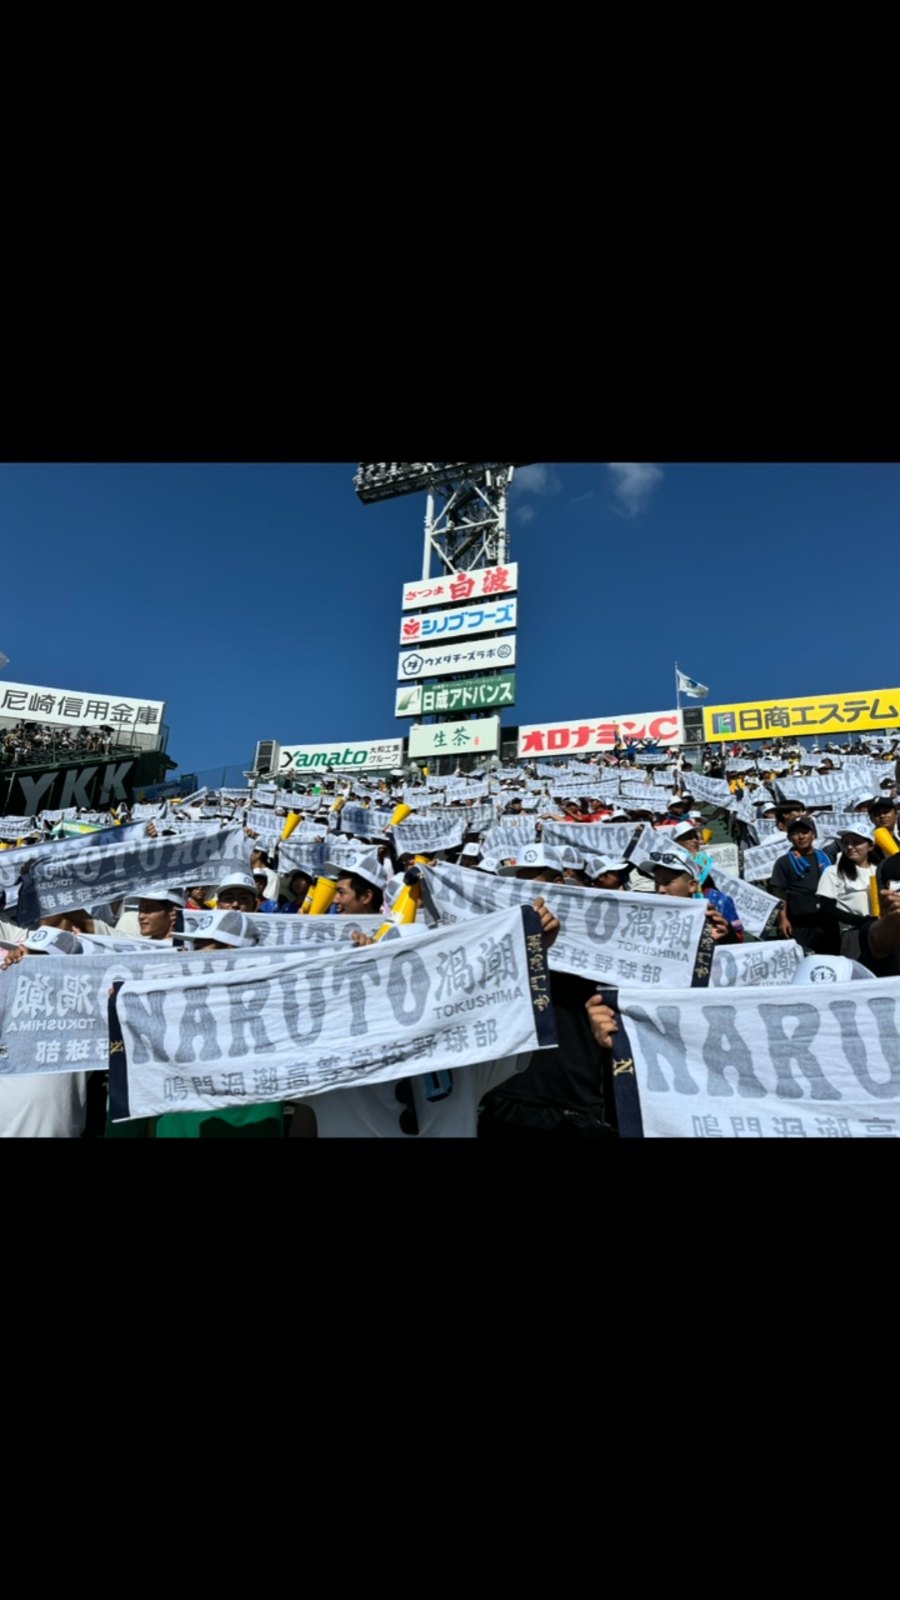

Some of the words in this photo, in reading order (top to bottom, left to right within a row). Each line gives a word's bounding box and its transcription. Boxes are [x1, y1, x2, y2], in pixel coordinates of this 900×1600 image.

[405, 587, 444, 601] さつま
[449, 567, 513, 600] 白波
[422, 604, 514, 635] シノブフーズ
[425, 648, 498, 667] ウメダチーズラボ
[1, 689, 160, 725] 尼崎信用金庫
[423, 682, 513, 711] 日成アドバンス
[739, 698, 899, 731] 日商エステム
[433, 727, 471, 748] 生茶
[522, 716, 679, 752] オロナミンC
[281, 748, 368, 768] Yamato
[369, 751, 398, 763] グループ
[18, 761, 134, 816] YKK
[617, 940, 690, 963] TOKUSHIMA
[122, 949, 431, 1066] NARUTO
[434, 932, 519, 1003] 渦潮
[433, 985, 524, 1020] TOKUSHIMA
